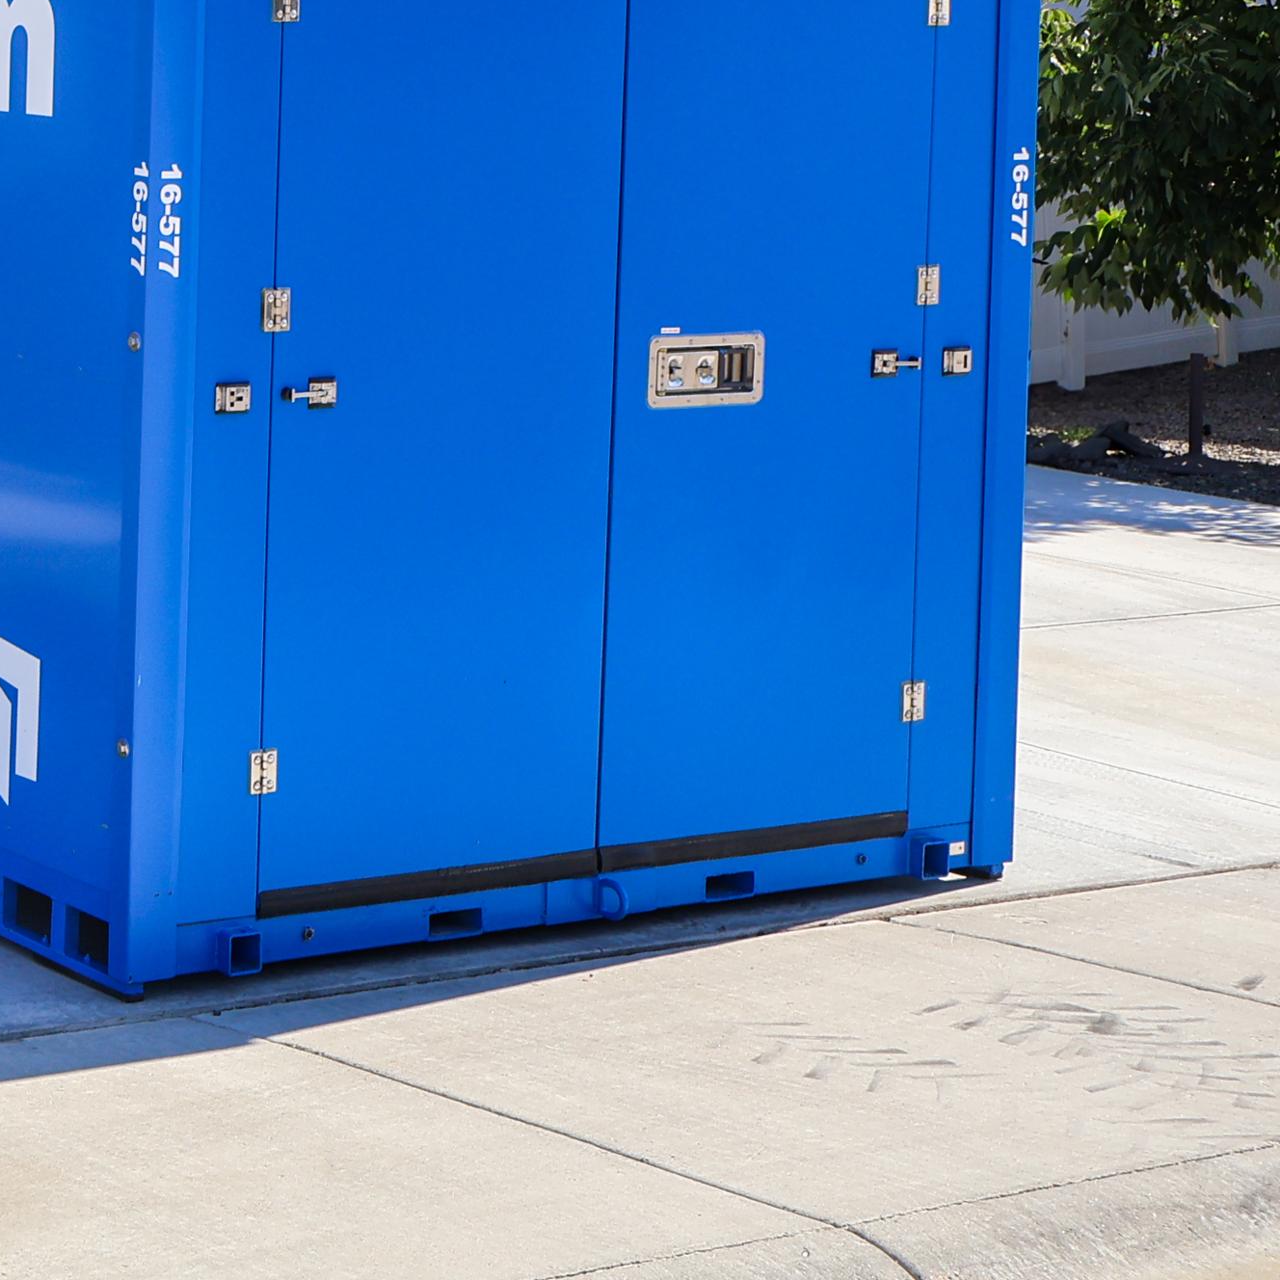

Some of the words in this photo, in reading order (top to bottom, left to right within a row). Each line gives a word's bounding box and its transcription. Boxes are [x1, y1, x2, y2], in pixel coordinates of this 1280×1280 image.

[130, 161, 149, 277] 16-577
[158, 163, 182, 278] 16-577
[1010, 146, 1030, 247] 16-577
